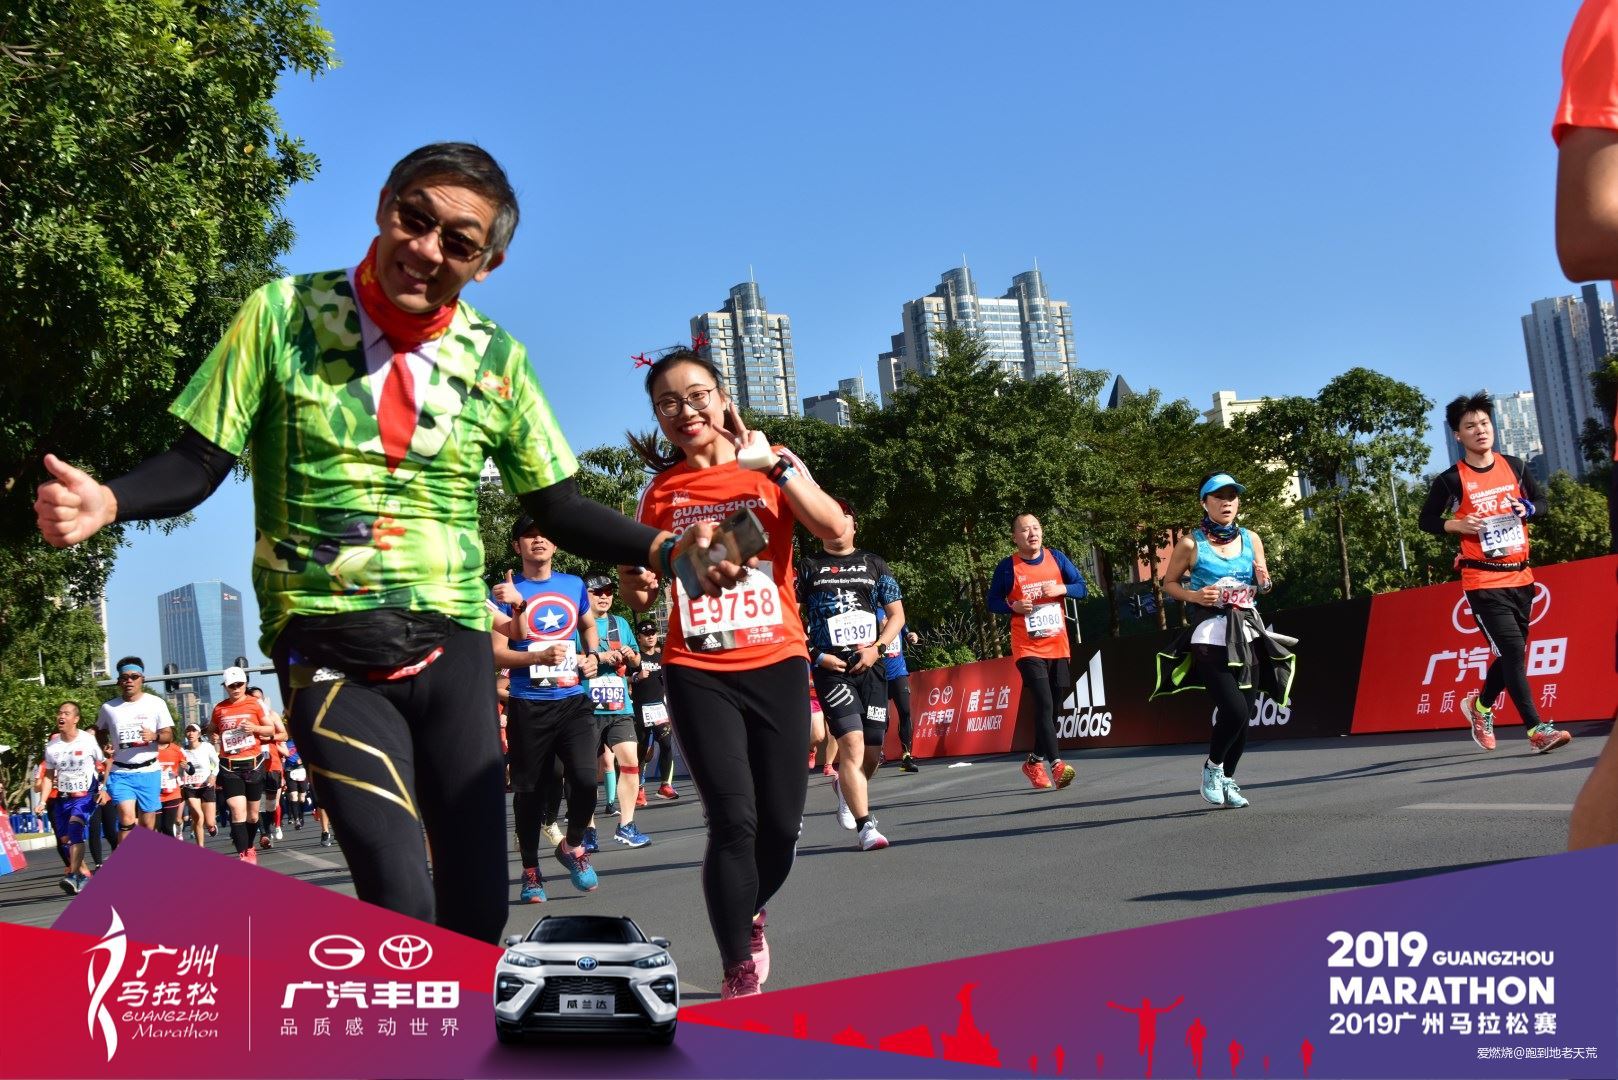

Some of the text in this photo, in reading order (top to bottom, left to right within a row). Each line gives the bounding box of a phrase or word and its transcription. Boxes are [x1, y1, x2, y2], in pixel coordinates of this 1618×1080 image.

[673, 499, 766, 519] GUANGZHOU
[820, 565, 867, 574] POLAR
[688, 588, 775, 627] E9758
[1422, 637, 1568, 685] 广汽田
[591, 687, 624, 700] C1962
[966, 685, 1011, 712] 威兰达
[918, 708, 955, 726] 广汽丰田
[1056, 706, 1112, 738] adidas
